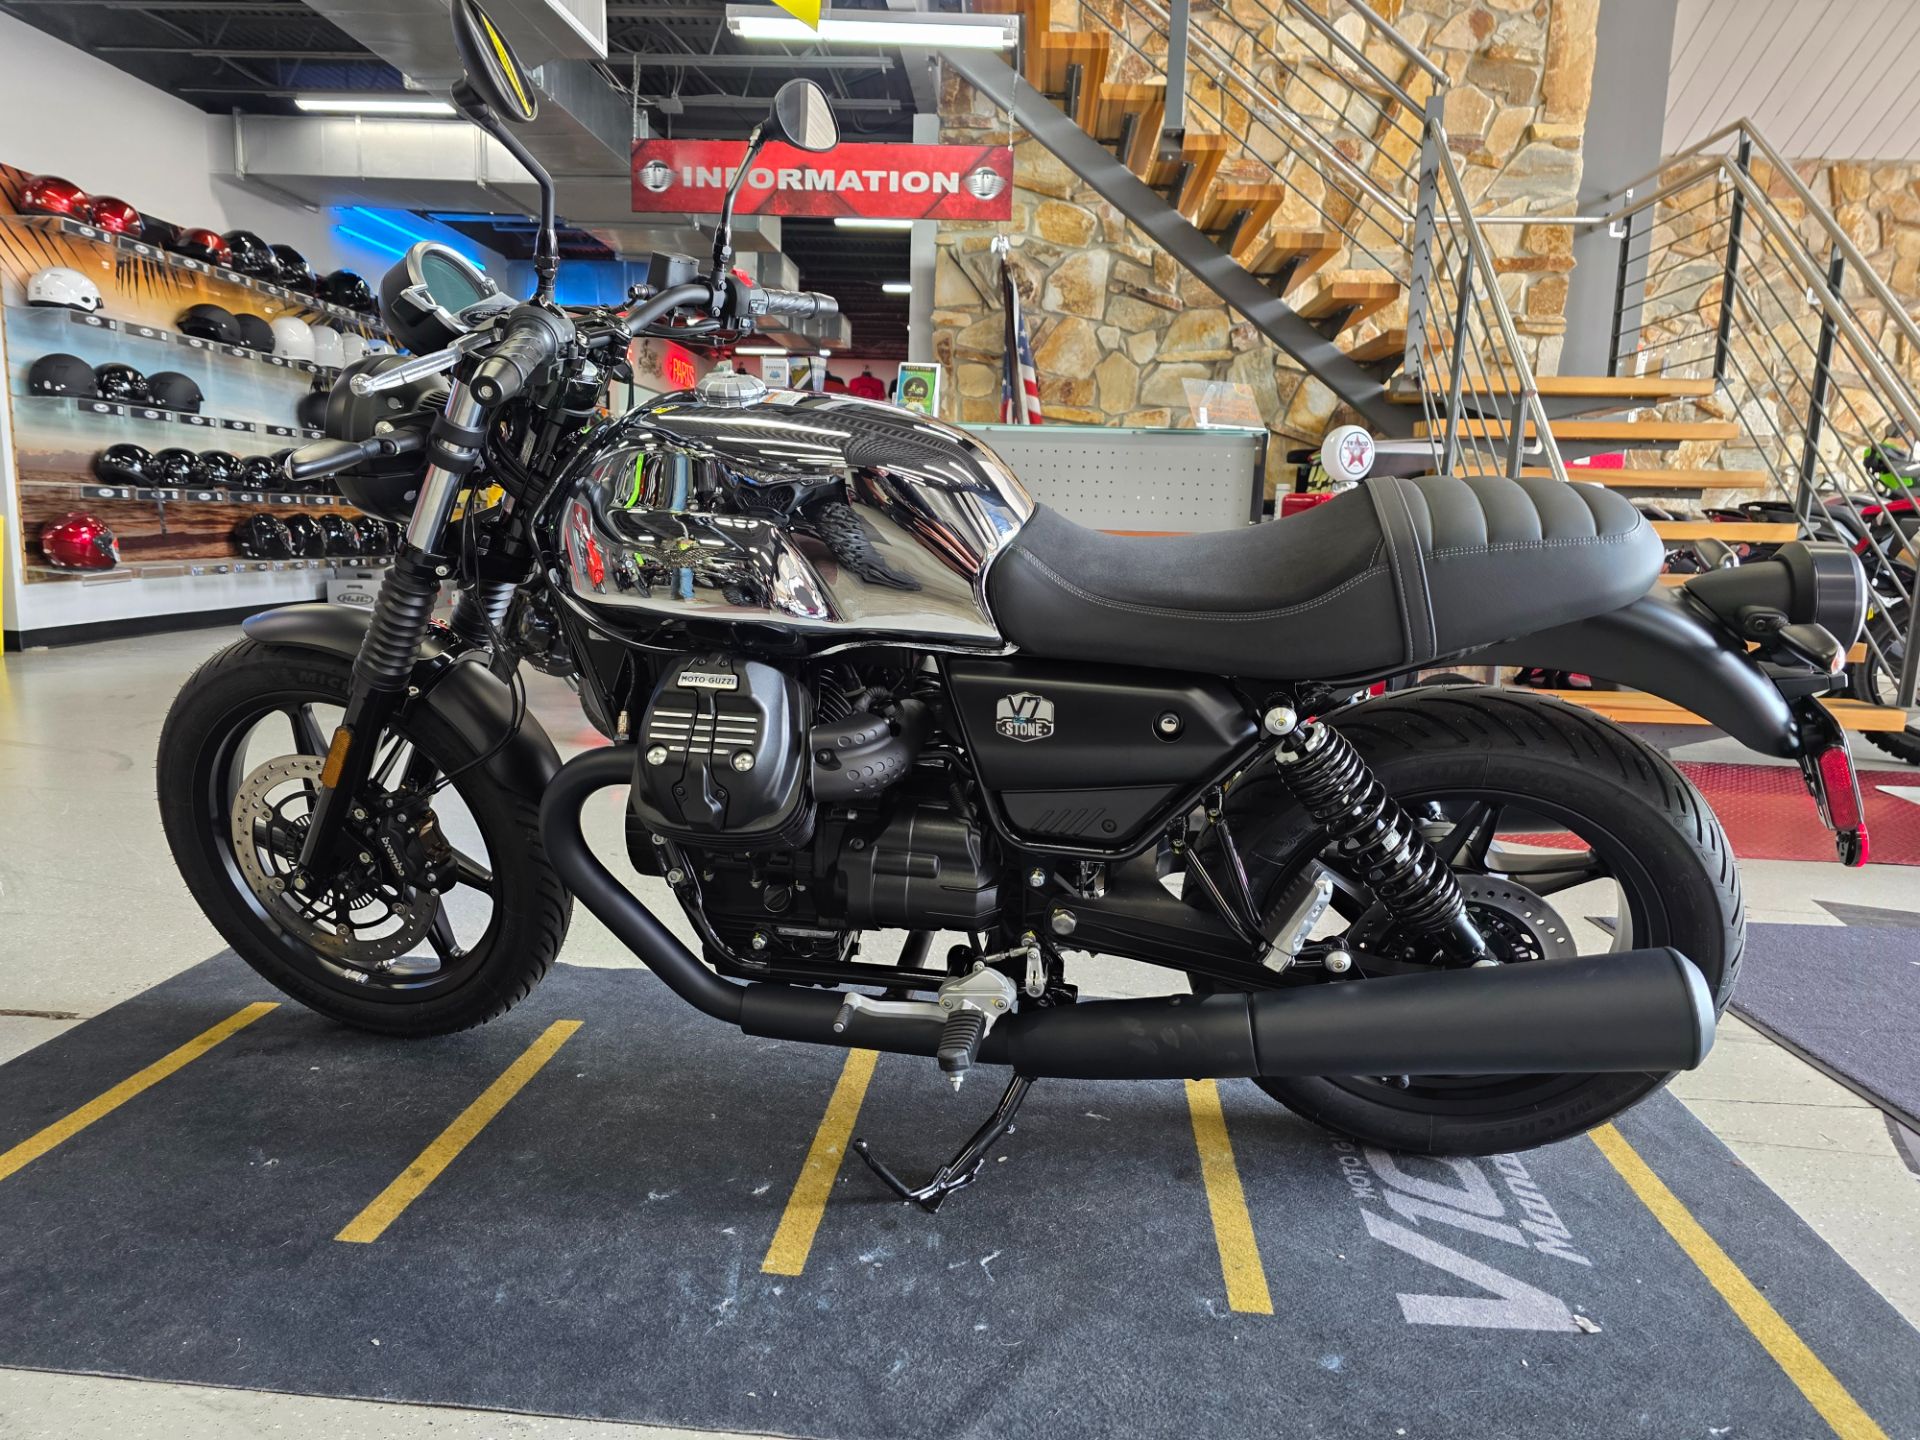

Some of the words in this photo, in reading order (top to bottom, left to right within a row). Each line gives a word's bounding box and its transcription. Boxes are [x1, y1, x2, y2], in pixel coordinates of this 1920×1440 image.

[682, 166, 960, 194] INFORMATION
[672, 358, 695, 388] PARTS
[681, 675, 706, 683] MOTO
[708, 677, 736, 685] GUZZI
[1007, 695, 1042, 718] V7
[1005, 721, 1043, 736] STONE
[381, 836, 405, 876] brembo
[1338, 1155, 1381, 1201] MOTO
